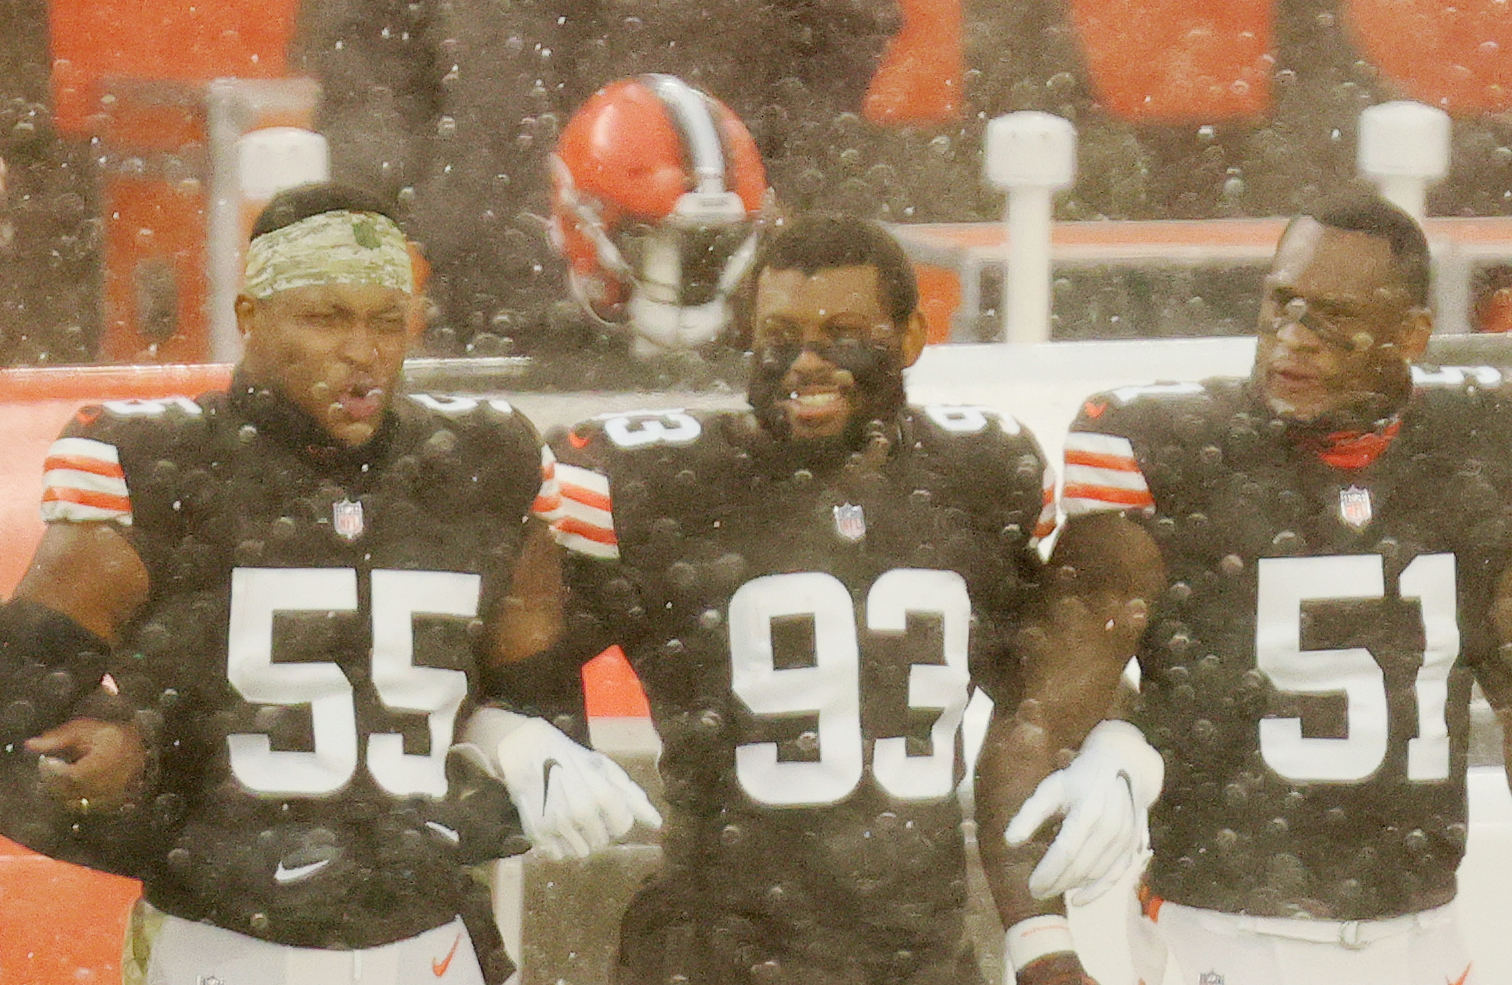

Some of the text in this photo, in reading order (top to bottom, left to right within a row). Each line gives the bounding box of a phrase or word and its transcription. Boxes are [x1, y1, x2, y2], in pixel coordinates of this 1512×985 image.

[227, 567, 481, 800] 55
[728, 568, 971, 808] 93
[1256, 553, 1460, 782] 51
